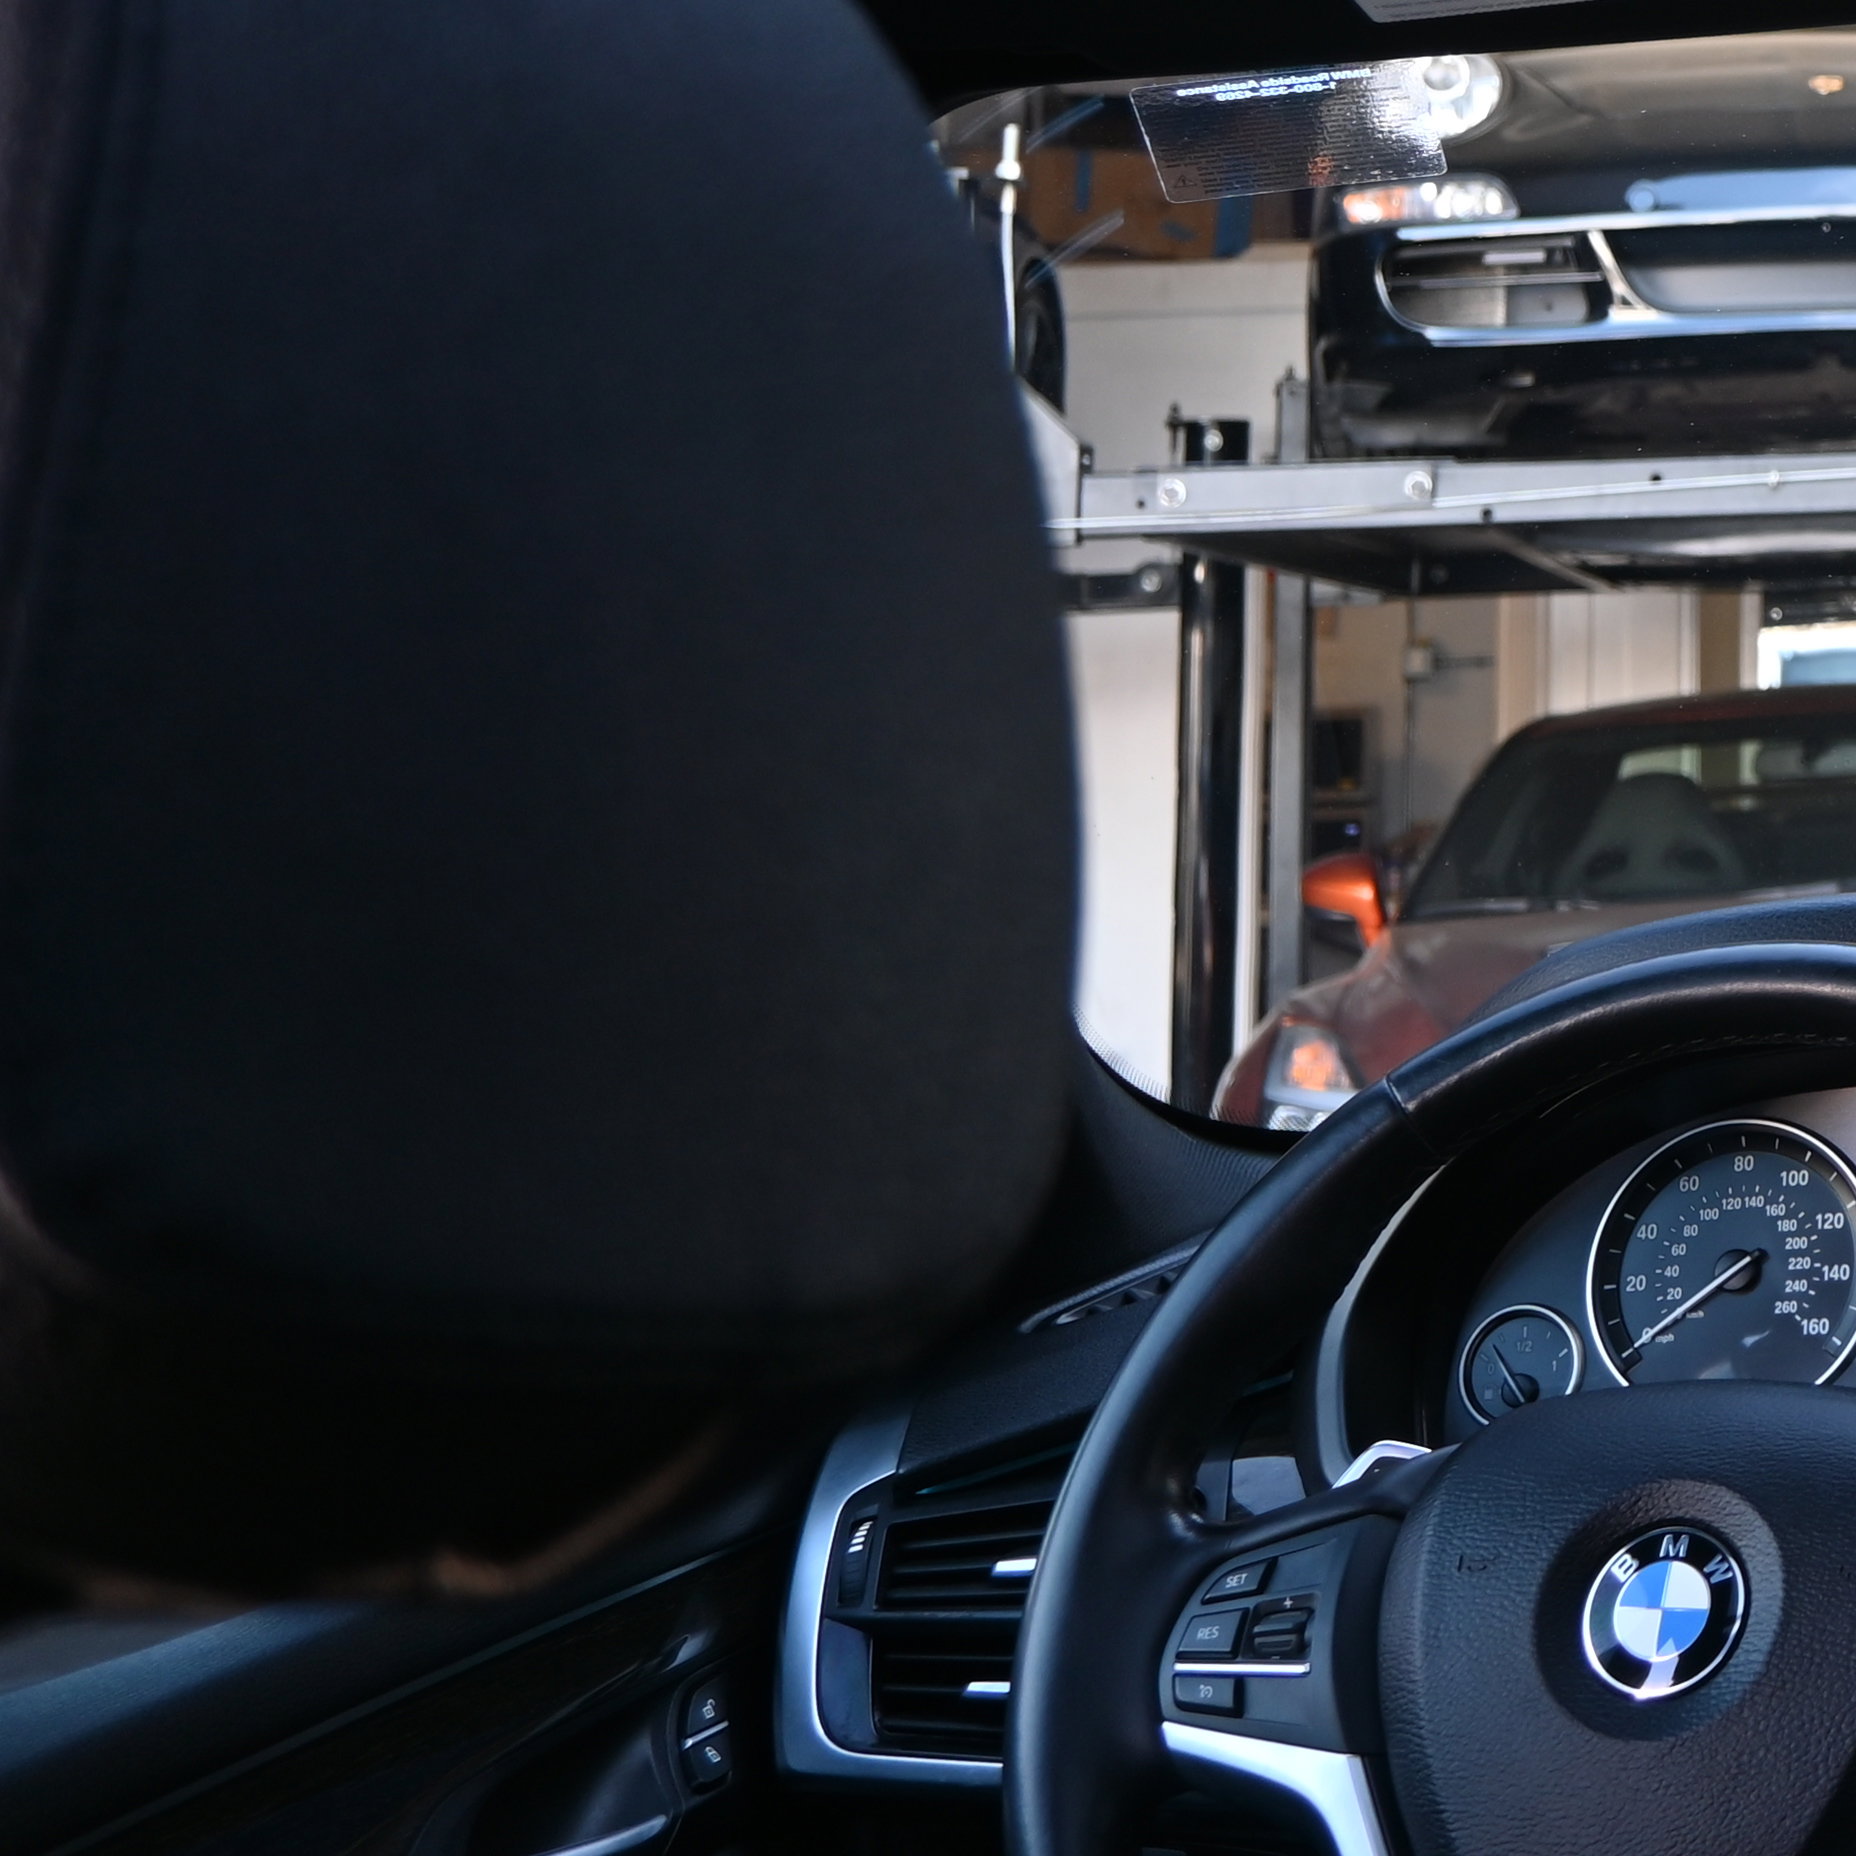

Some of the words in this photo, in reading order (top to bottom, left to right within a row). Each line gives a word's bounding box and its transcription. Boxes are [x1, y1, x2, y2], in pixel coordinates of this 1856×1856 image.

[1734, 1155, 1754, 1172] 80
[1679, 1175, 1699, 1192] 60
[1780, 1170, 1809, 1186] 100
[1721, 1197, 1742, 1210] 120
[1744, 1195, 1764, 1208] 140
[1699, 1207, 1719, 1220] 100
[1765, 1204, 1785, 1217] 160
[1777, 1219, 1797, 1232] 180
[1815, 1212, 1844, 1229] 120
[1637, 1224, 1657, 1240] 40
[1683, 1224, 1698, 1237] 80
[1785, 1236, 1808, 1250] 200
[1671, 1244, 1686, 1256] 60
[1788, 1257, 1811, 1270] 220
[1664, 1265, 1680, 1277] 40
[1822, 1264, 1850, 1281] 140
[1626, 1275, 1646, 1292] 20
[1785, 1280, 1808, 1293] 240
[1667, 1287, 1682, 1300] 20
[1774, 1301, 1797, 1314] 260
[1801, 1318, 1829, 1336] 160
[1516, 1341, 1533, 1352] 1/2
[1610, 1534, 1734, 1585] BMW
[1225, 1573, 1248, 1588] SET
[1197, 1626, 1220, 1641] RES
